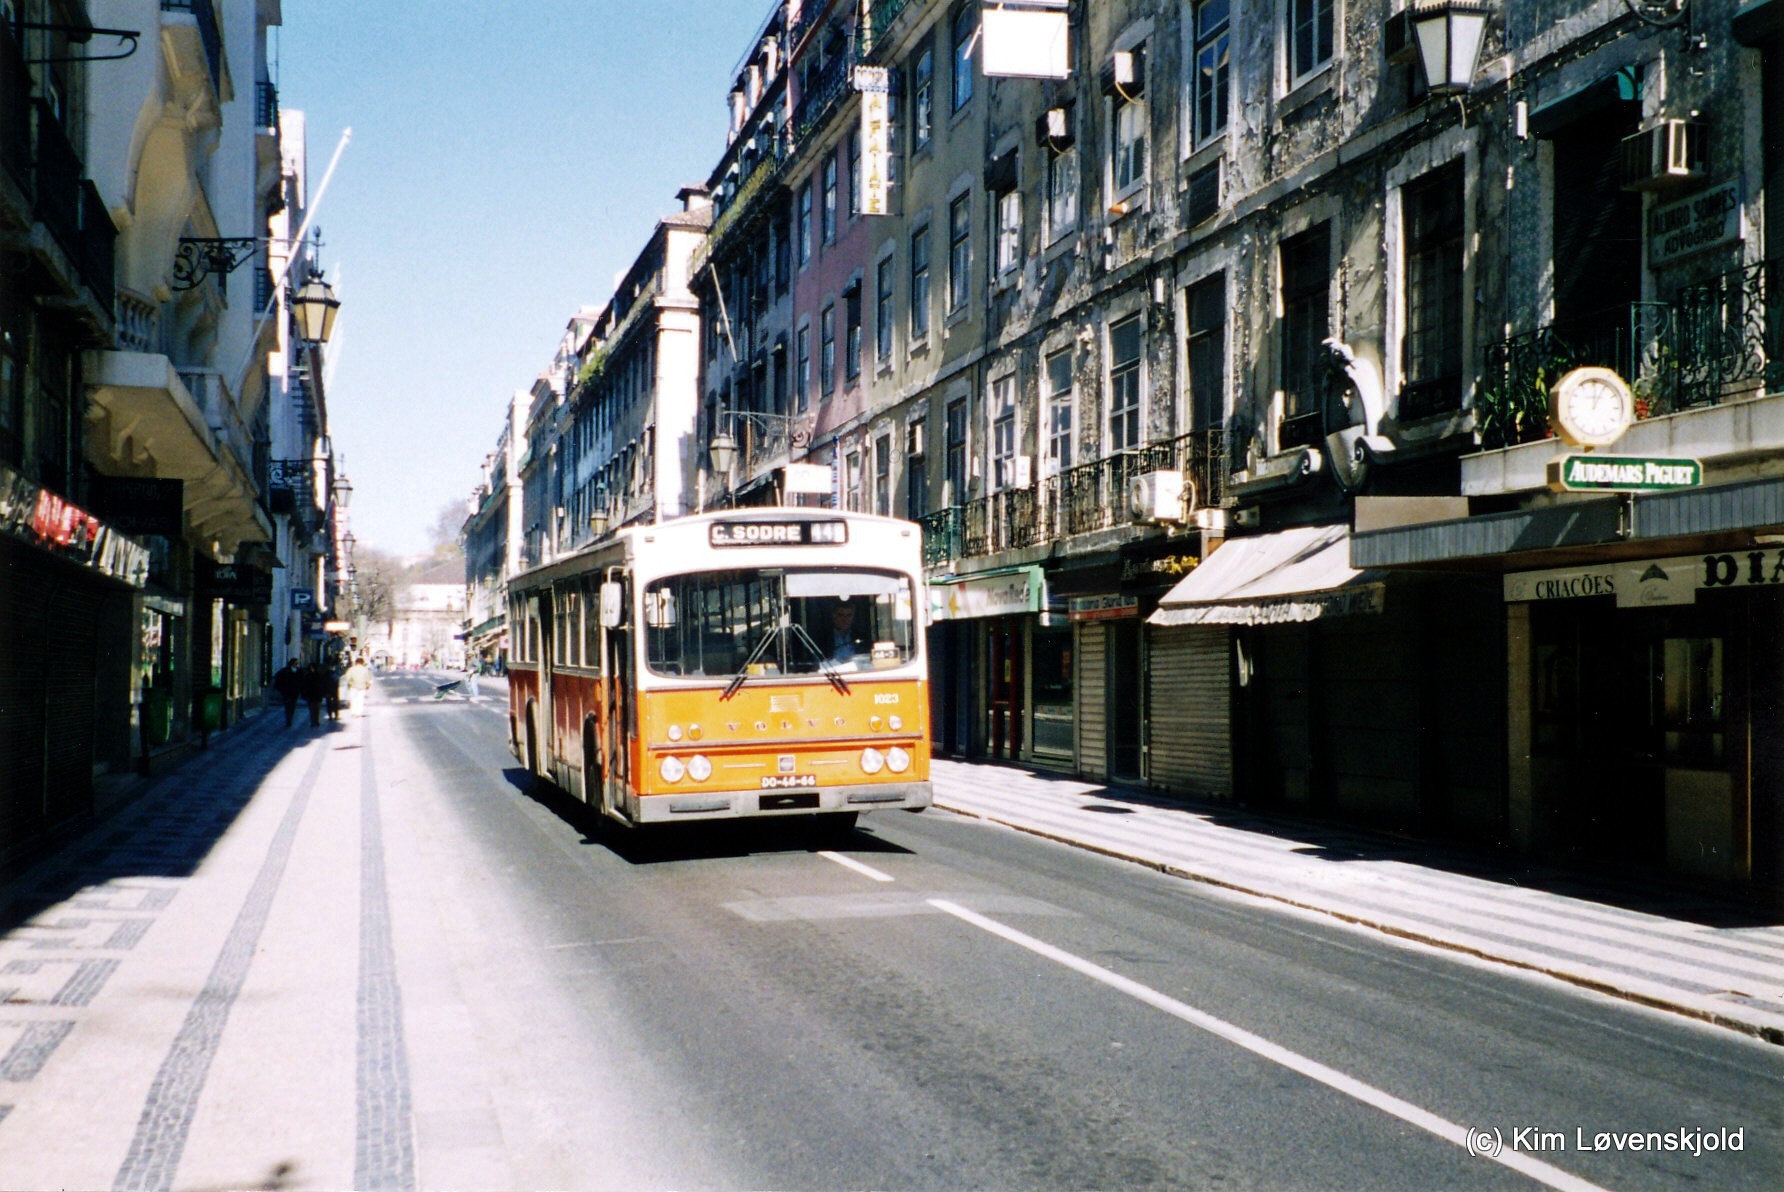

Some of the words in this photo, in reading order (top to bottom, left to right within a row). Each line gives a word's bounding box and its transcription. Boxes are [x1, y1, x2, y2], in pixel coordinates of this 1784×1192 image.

[1568, 460, 1643, 483] AUDEMARS
[1644, 462, 1695, 485] PIGUET
[294, 592, 312, 605] P
[874, 693, 899, 704] 1023
[725, 717, 847, 732] VOLVO
